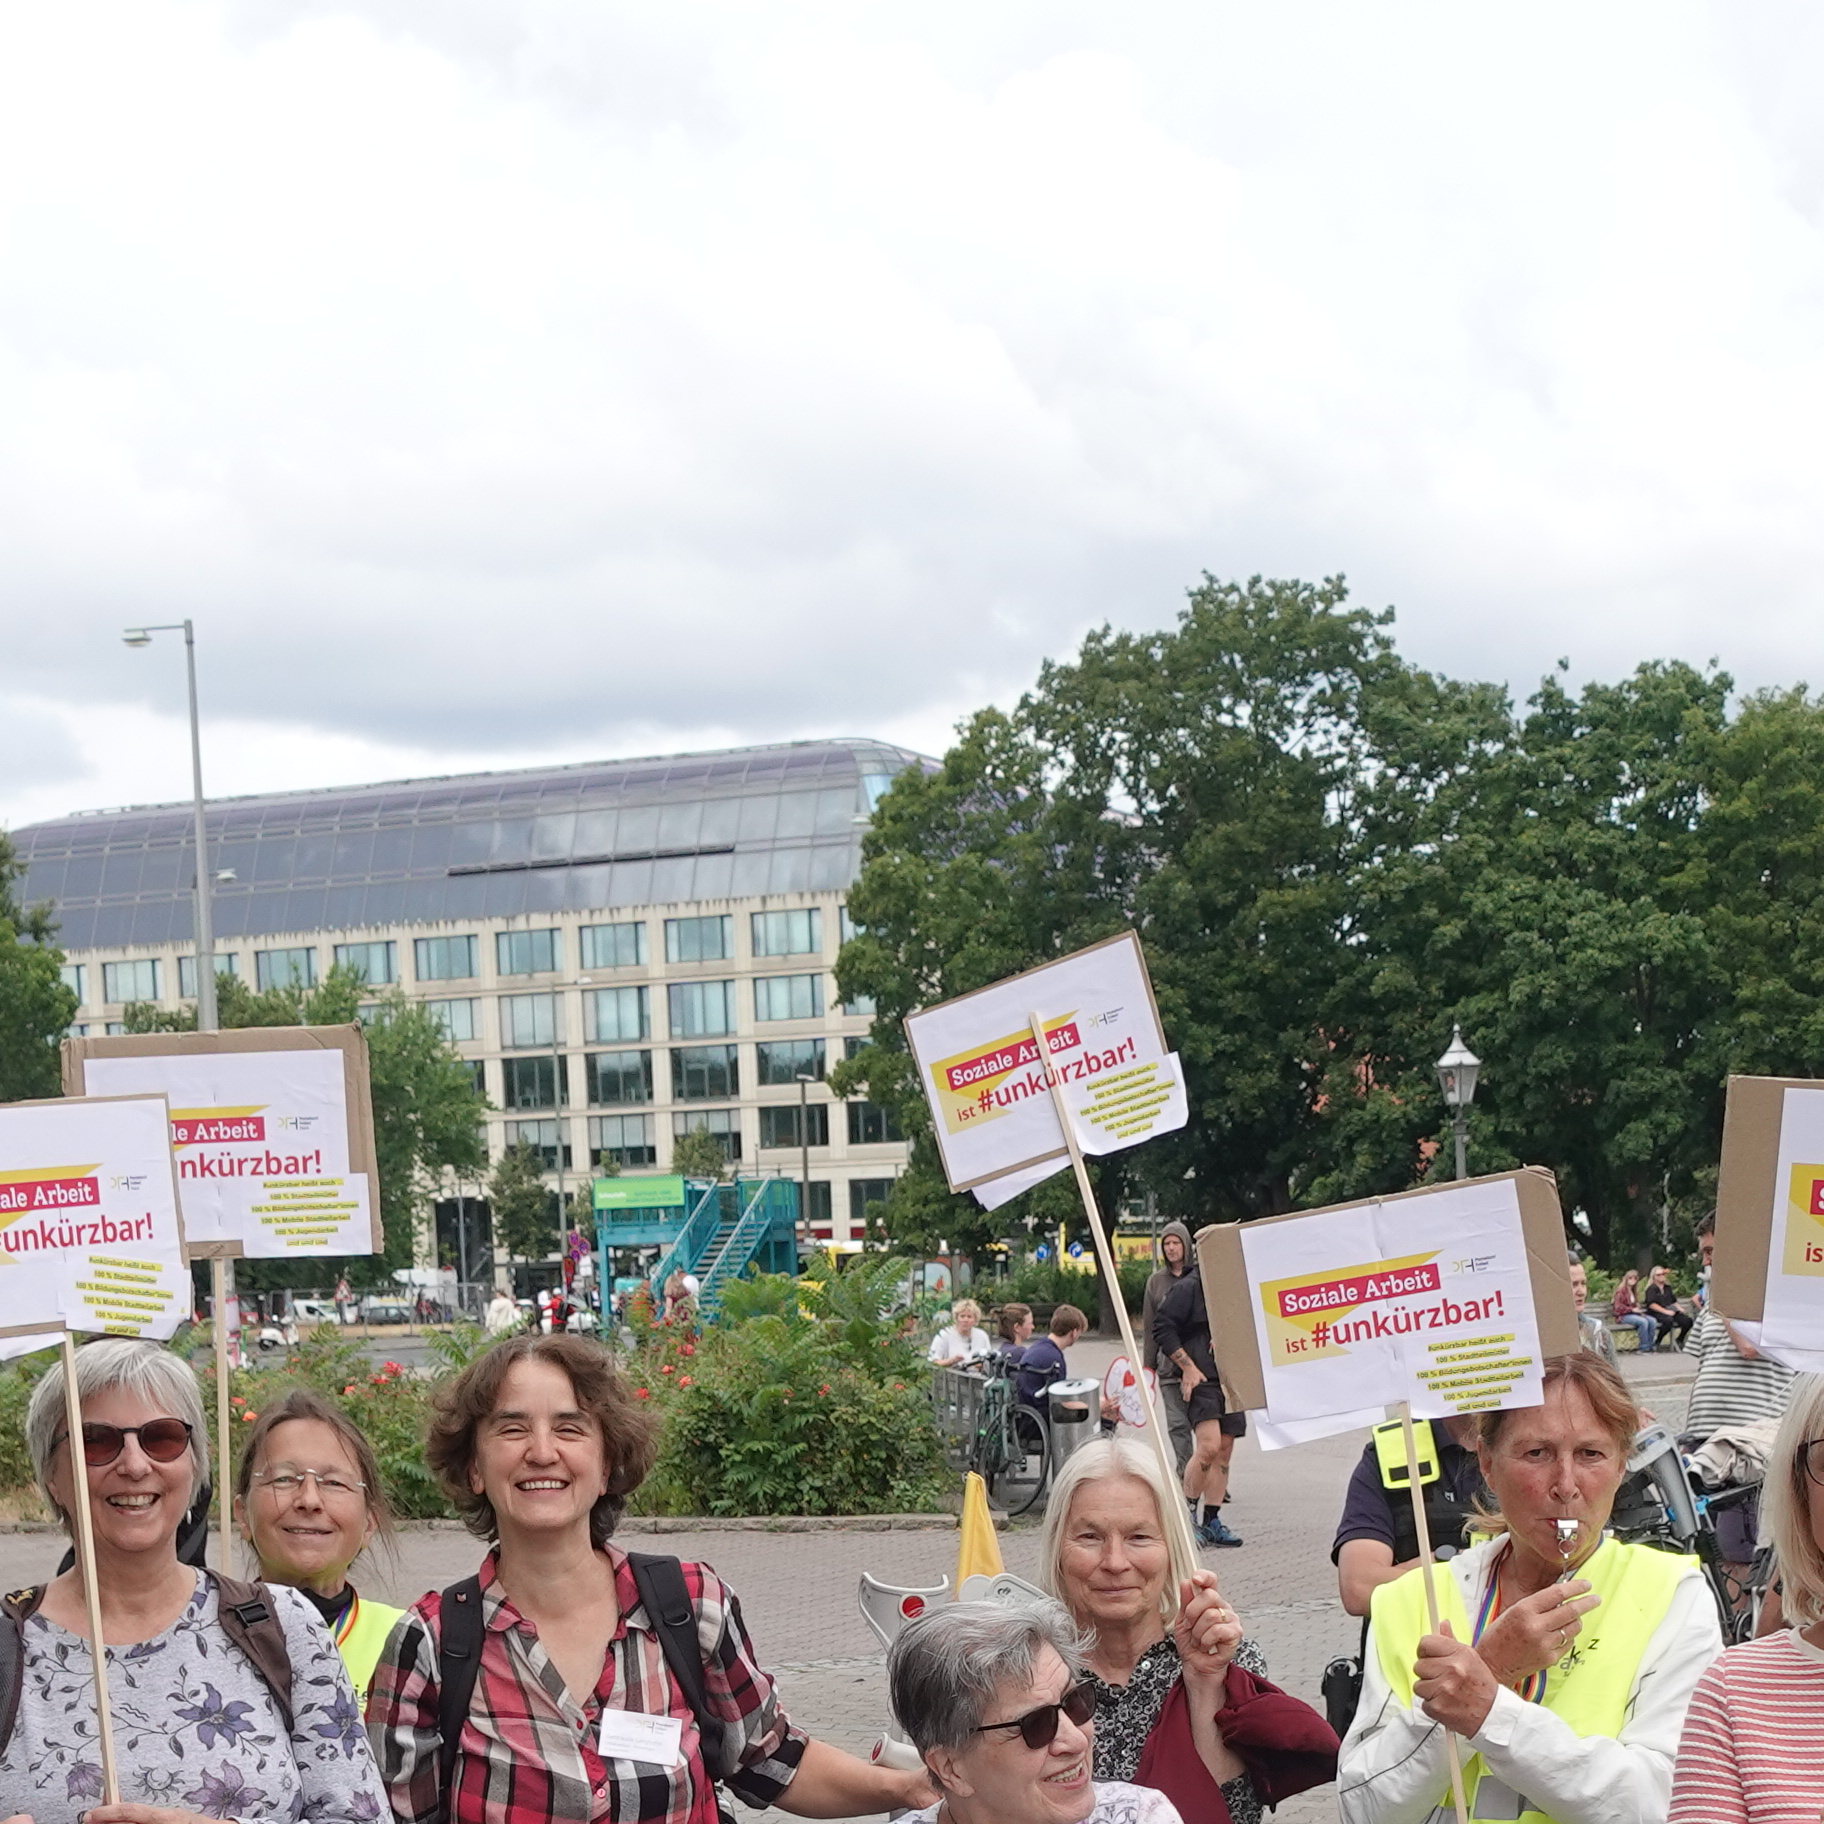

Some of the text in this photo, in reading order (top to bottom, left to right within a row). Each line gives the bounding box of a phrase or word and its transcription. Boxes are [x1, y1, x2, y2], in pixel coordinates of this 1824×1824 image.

[952, 1031, 1074, 1085] Soziale Areit
[956, 1106, 977, 1122] ist
[194, 1121, 257, 1140] Arbeit
[180, 1149, 321, 1180] nkürzbar!
[34, 1182, 93, 1206] Arbeit
[1285, 1270, 1432, 1312] Soziale Arbeit
[1285, 1290, 1505, 1353] ist #unkürzbar!
